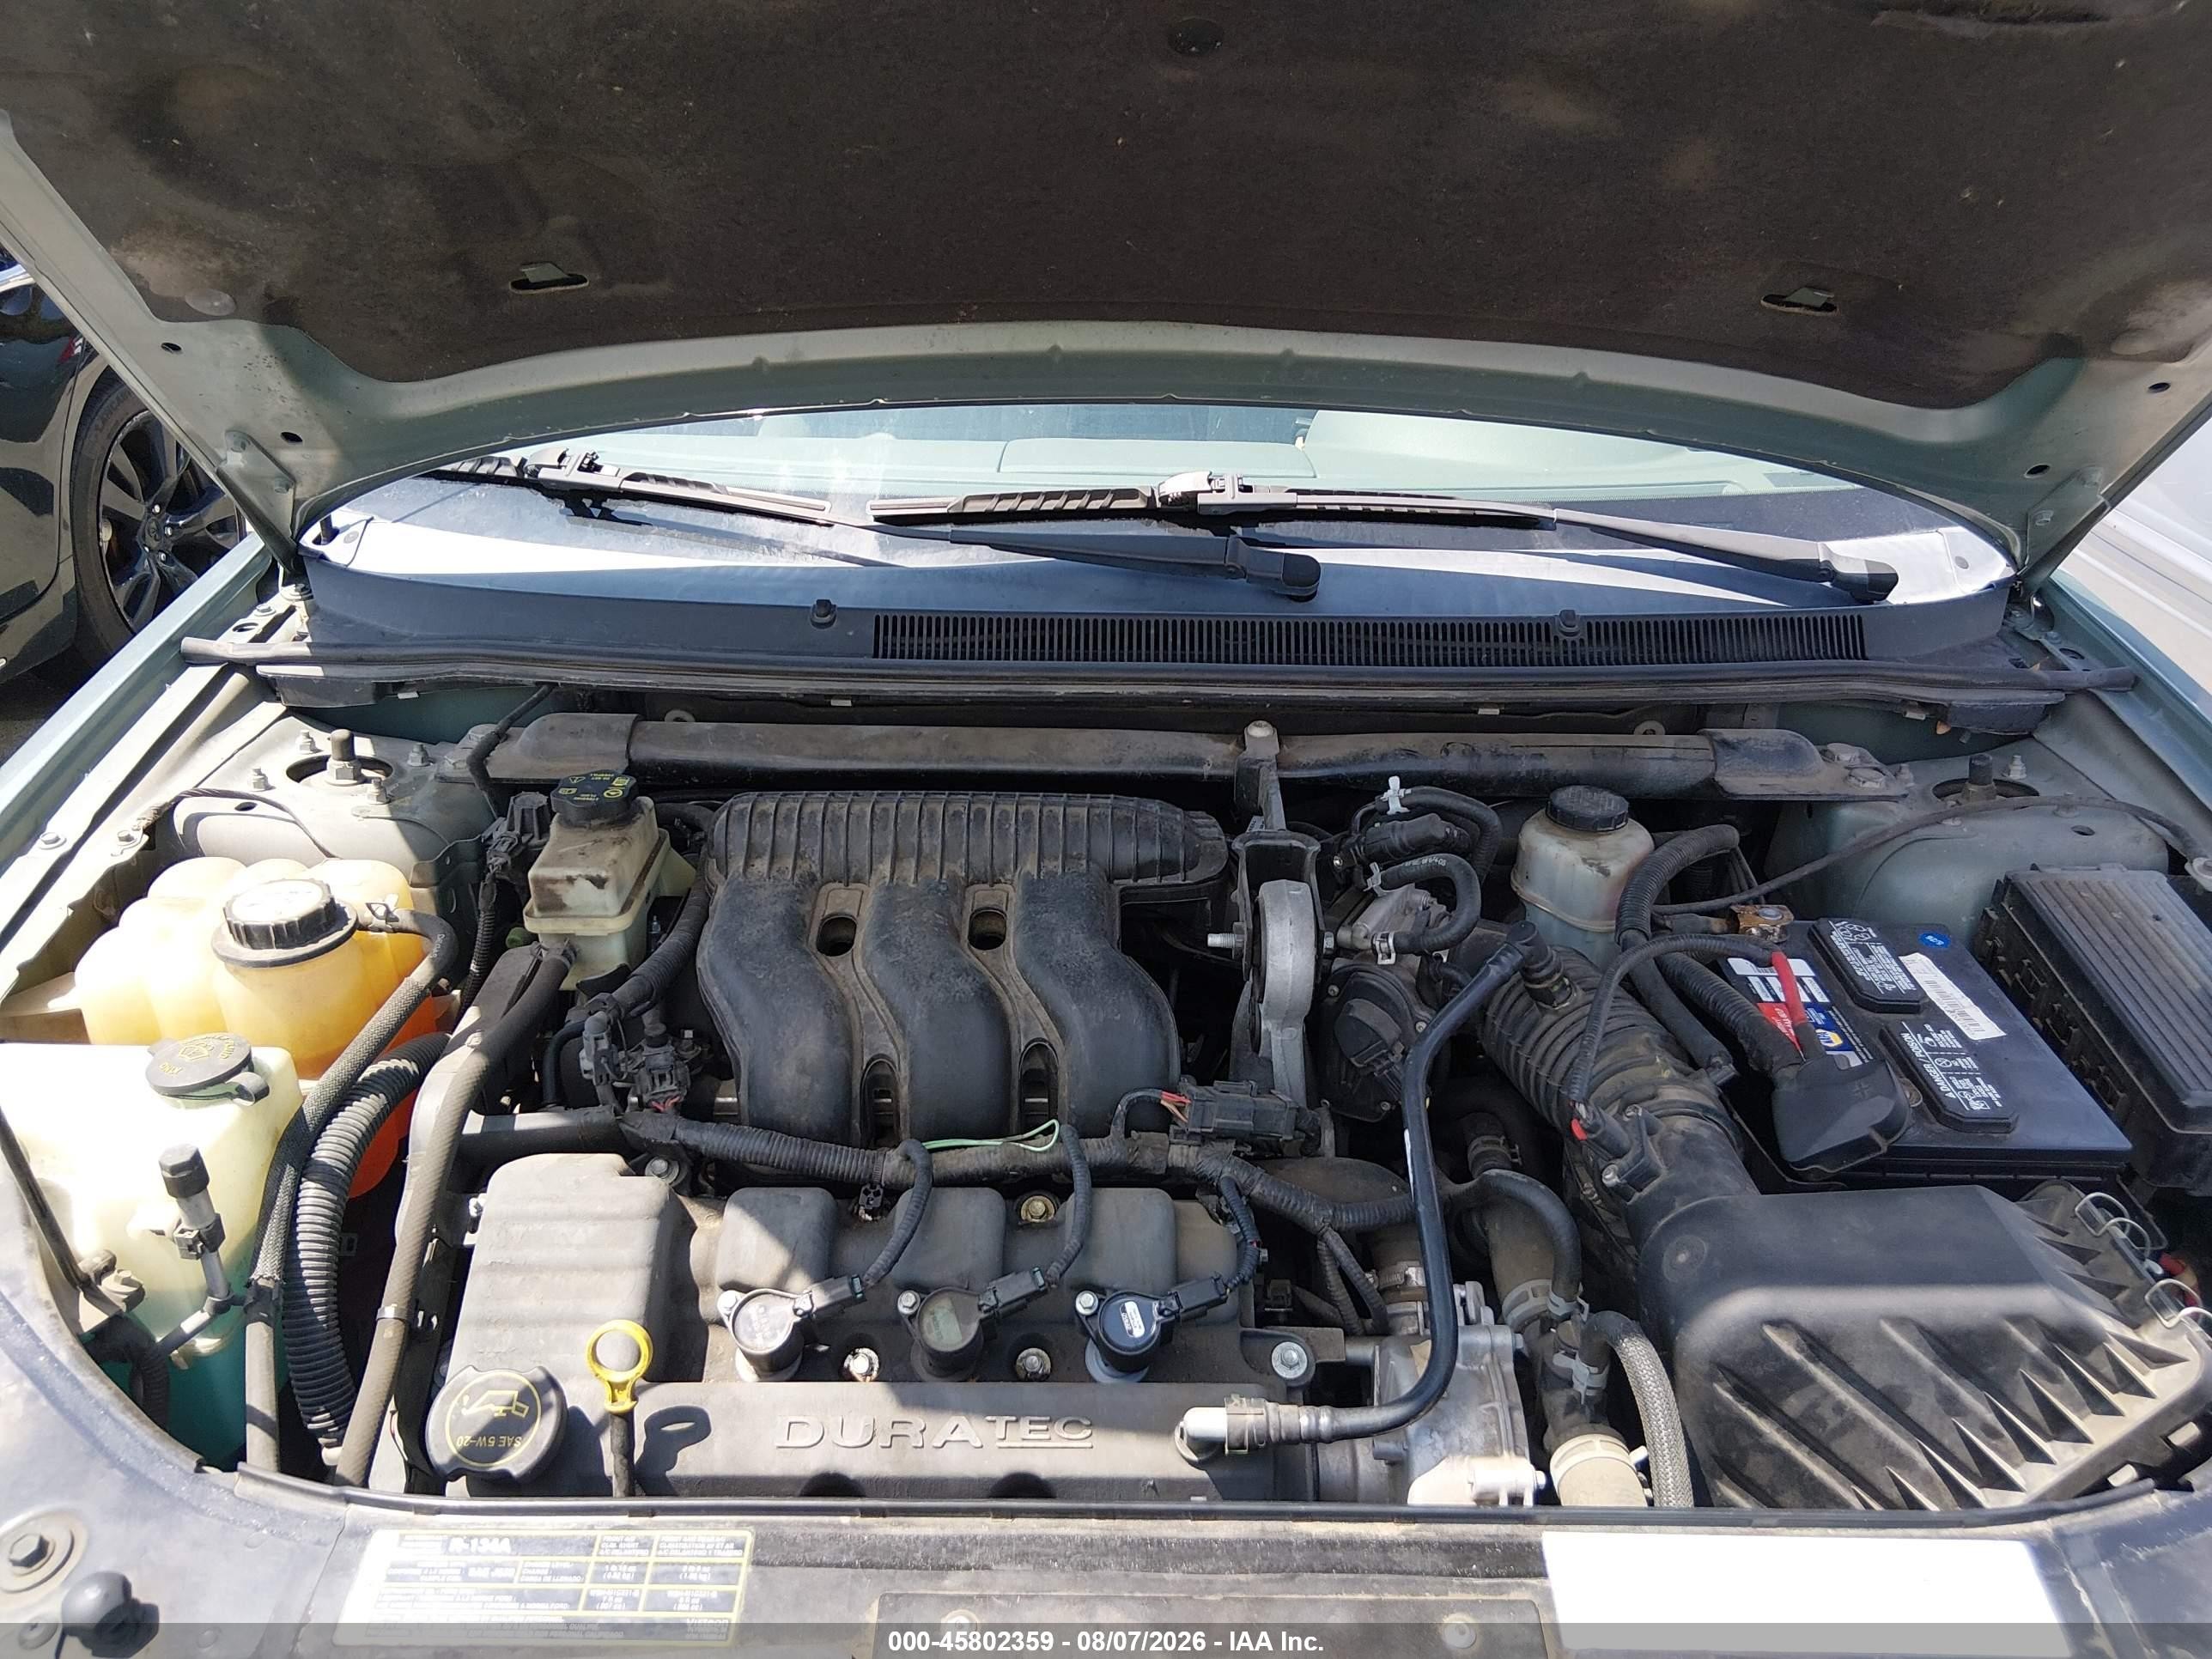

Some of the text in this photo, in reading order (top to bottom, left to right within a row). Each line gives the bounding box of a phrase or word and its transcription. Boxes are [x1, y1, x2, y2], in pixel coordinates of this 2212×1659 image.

[1900, 1032, 1925, 1058] POISON
[1923, 1063, 1952, 1092] DANGER
[456, 1435, 522, 1448] SAE 5W-20
[775, 1415, 1093, 1449] DURATEC
